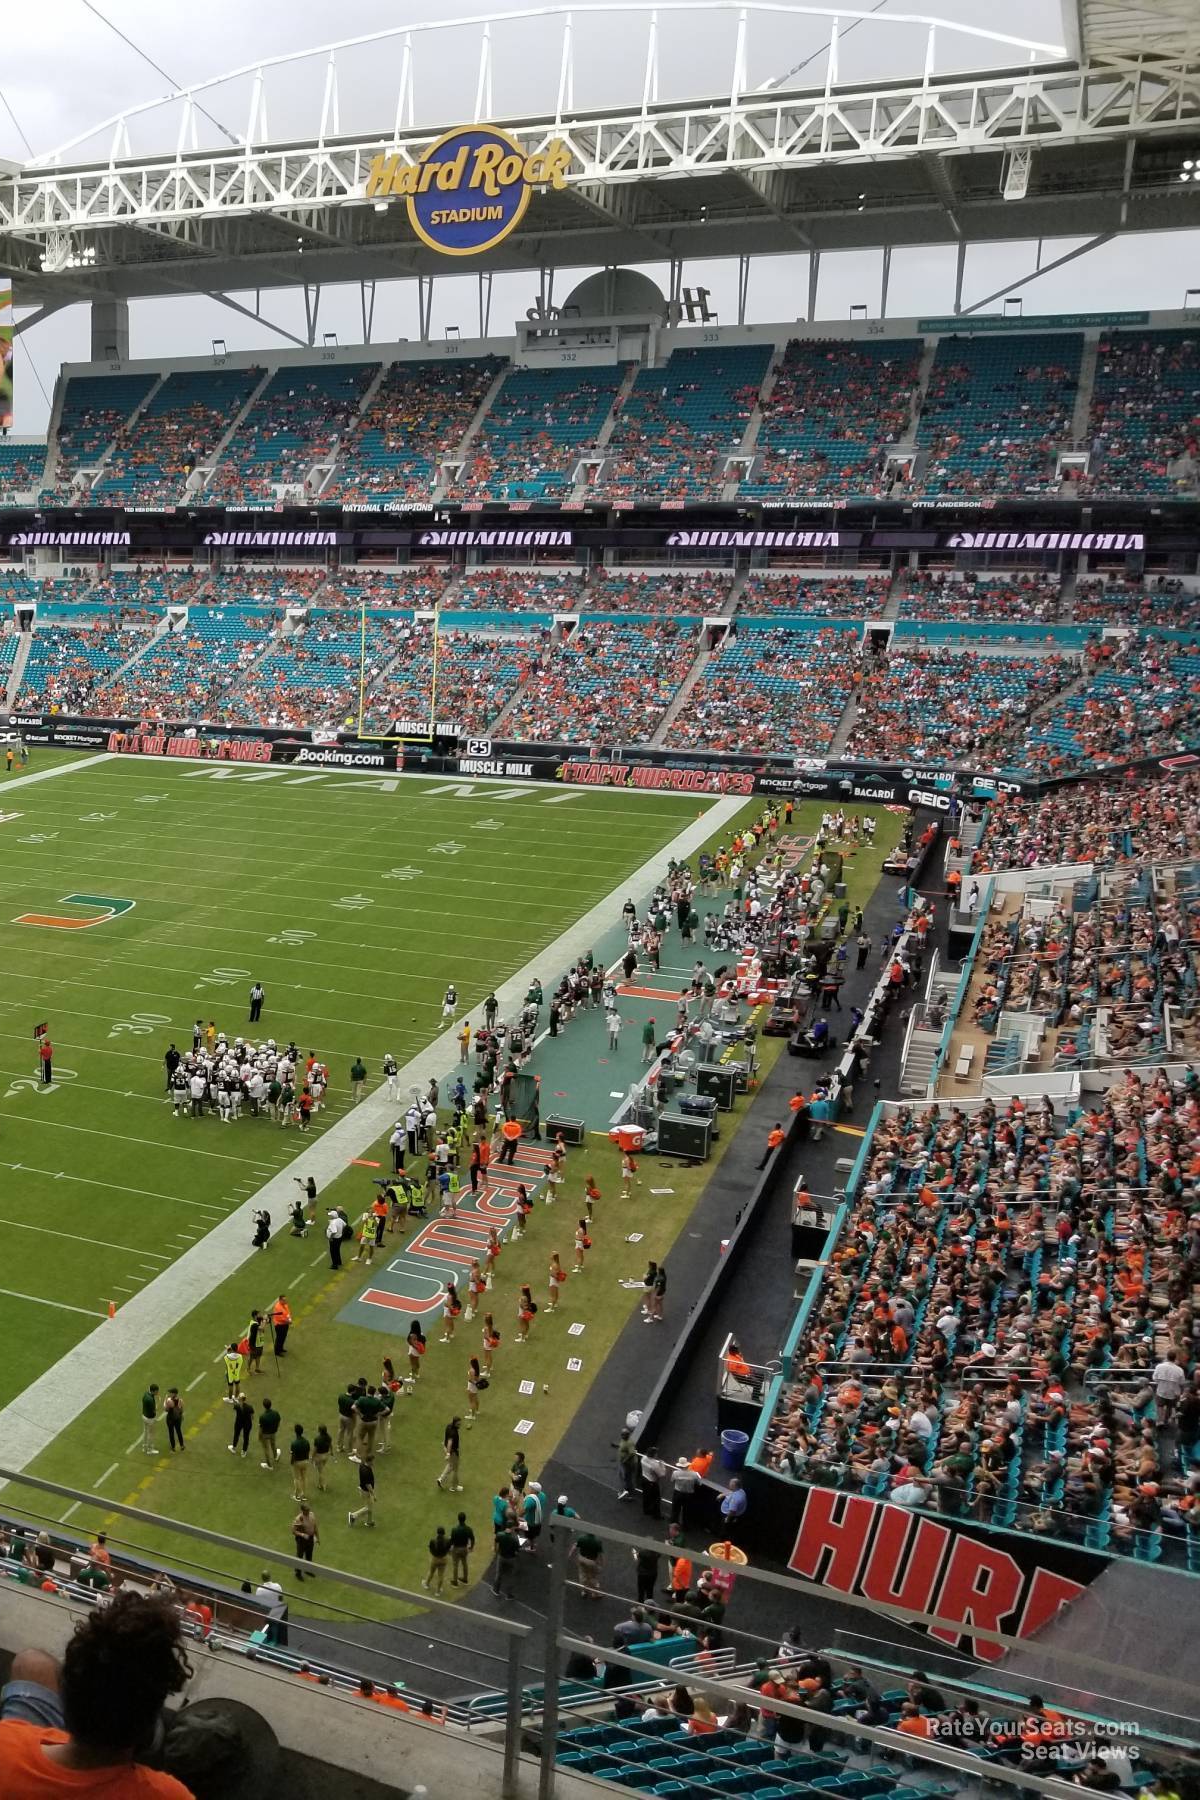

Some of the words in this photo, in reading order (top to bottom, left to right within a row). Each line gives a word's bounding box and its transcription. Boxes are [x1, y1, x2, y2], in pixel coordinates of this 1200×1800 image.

[367, 144, 469, 198] Hard
[470, 137, 573, 197] Rock
[430, 205, 503, 225] STADIUM
[703, 333, 719, 343] 333
[561, 353, 577, 362] 332
[342, 504, 381, 512] NATIONAL
[384, 503, 433, 512] CHAMPIONS
[785, 501, 833, 509] TESTAVERDE
[395, 722, 435, 735] MUSCLE
[436, 723, 462, 736] MILK
[470, 741, 488, 754] 25
[300, 748, 385, 766] Booking.com
[460, 759, 503, 775] MUSCLE
[506, 763, 532, 776] MILK
[179, 767, 587, 803] MIAMI
[760, 779, 792, 787] ROCKET
[854, 786, 895, 799] BACARDÍ
[267, 929, 318, 945] 50
[201, 967, 252, 986] 40
[112, 1013, 173, 1034] 30
[10, 1067, 79, 1094] 20
